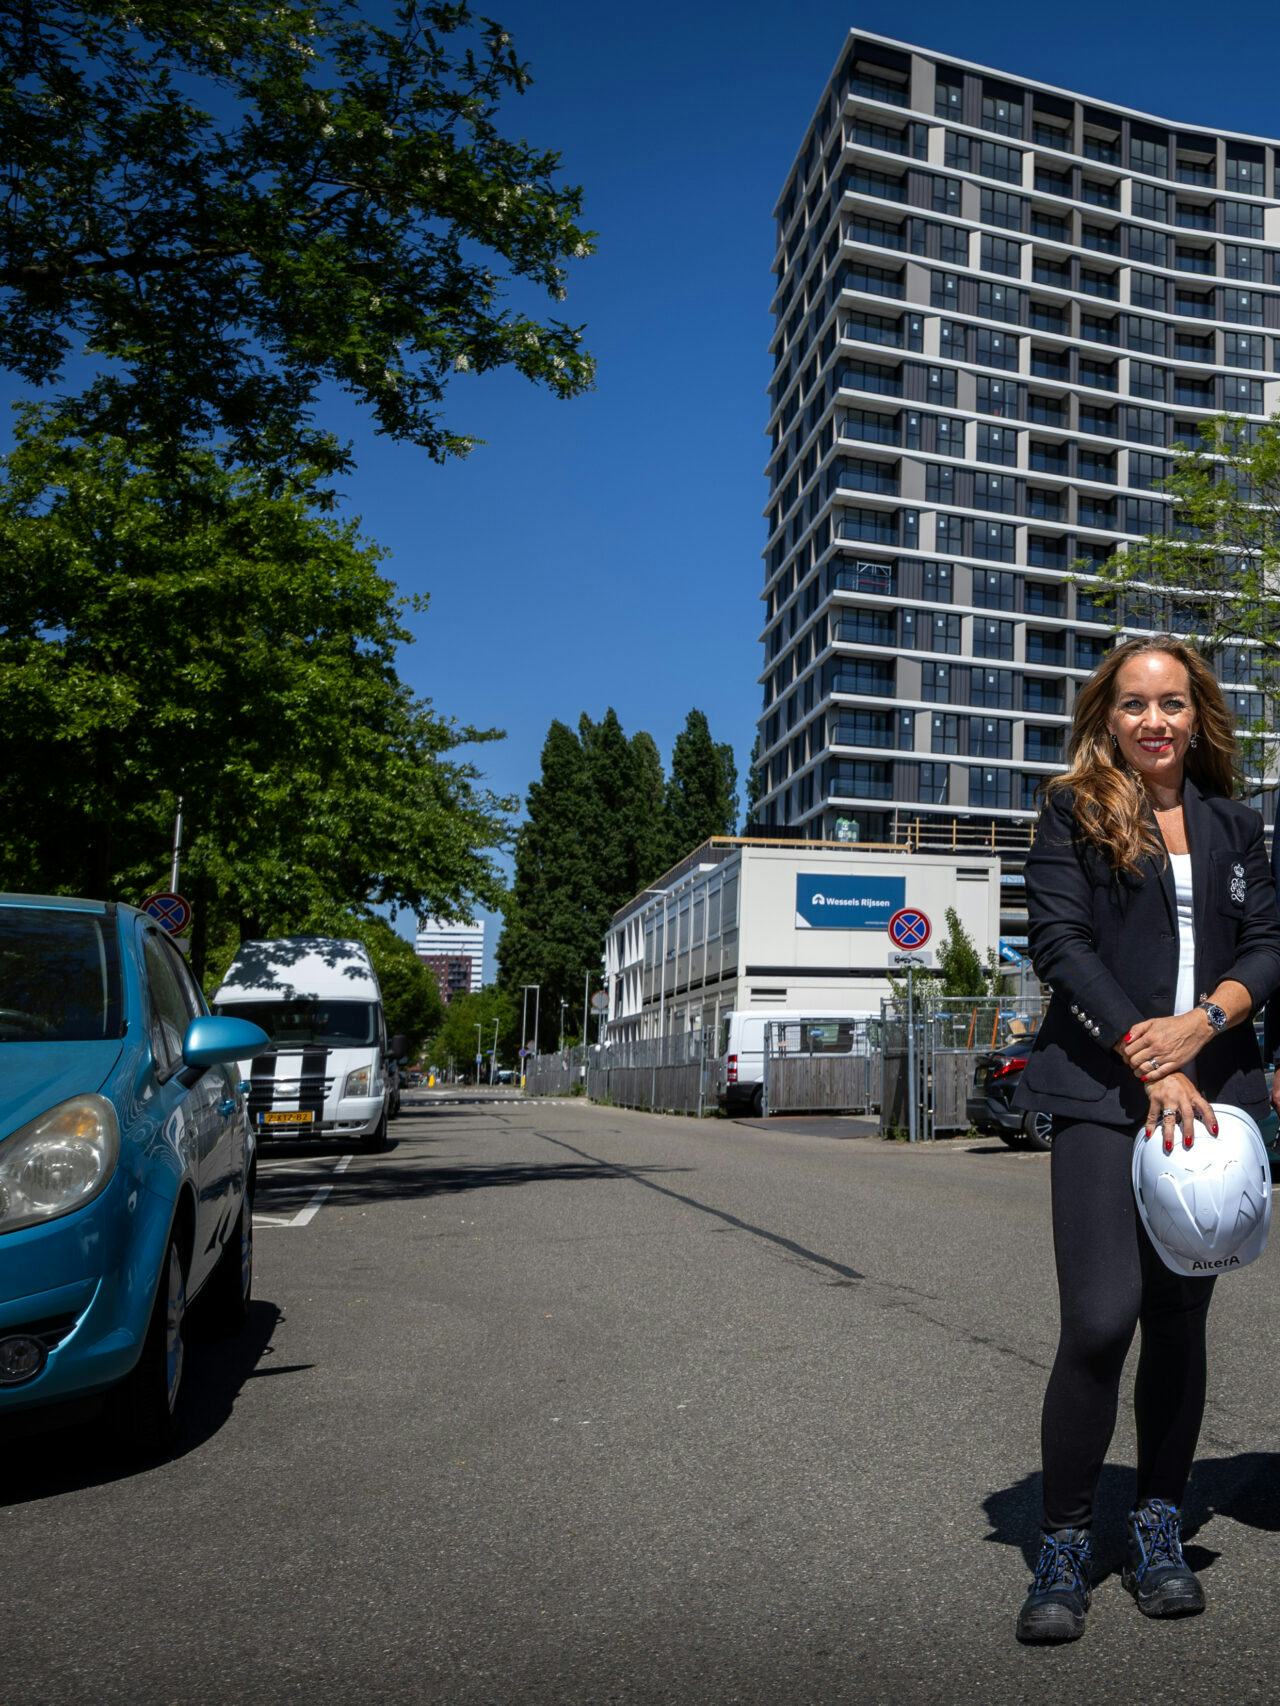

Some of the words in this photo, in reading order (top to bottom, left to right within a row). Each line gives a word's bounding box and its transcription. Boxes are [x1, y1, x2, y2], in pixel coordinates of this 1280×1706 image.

[826, 897, 859, 906] Wessels
[861, 898, 890, 908] Rijssen
[1192, 1255, 1240, 1271] AlterA
